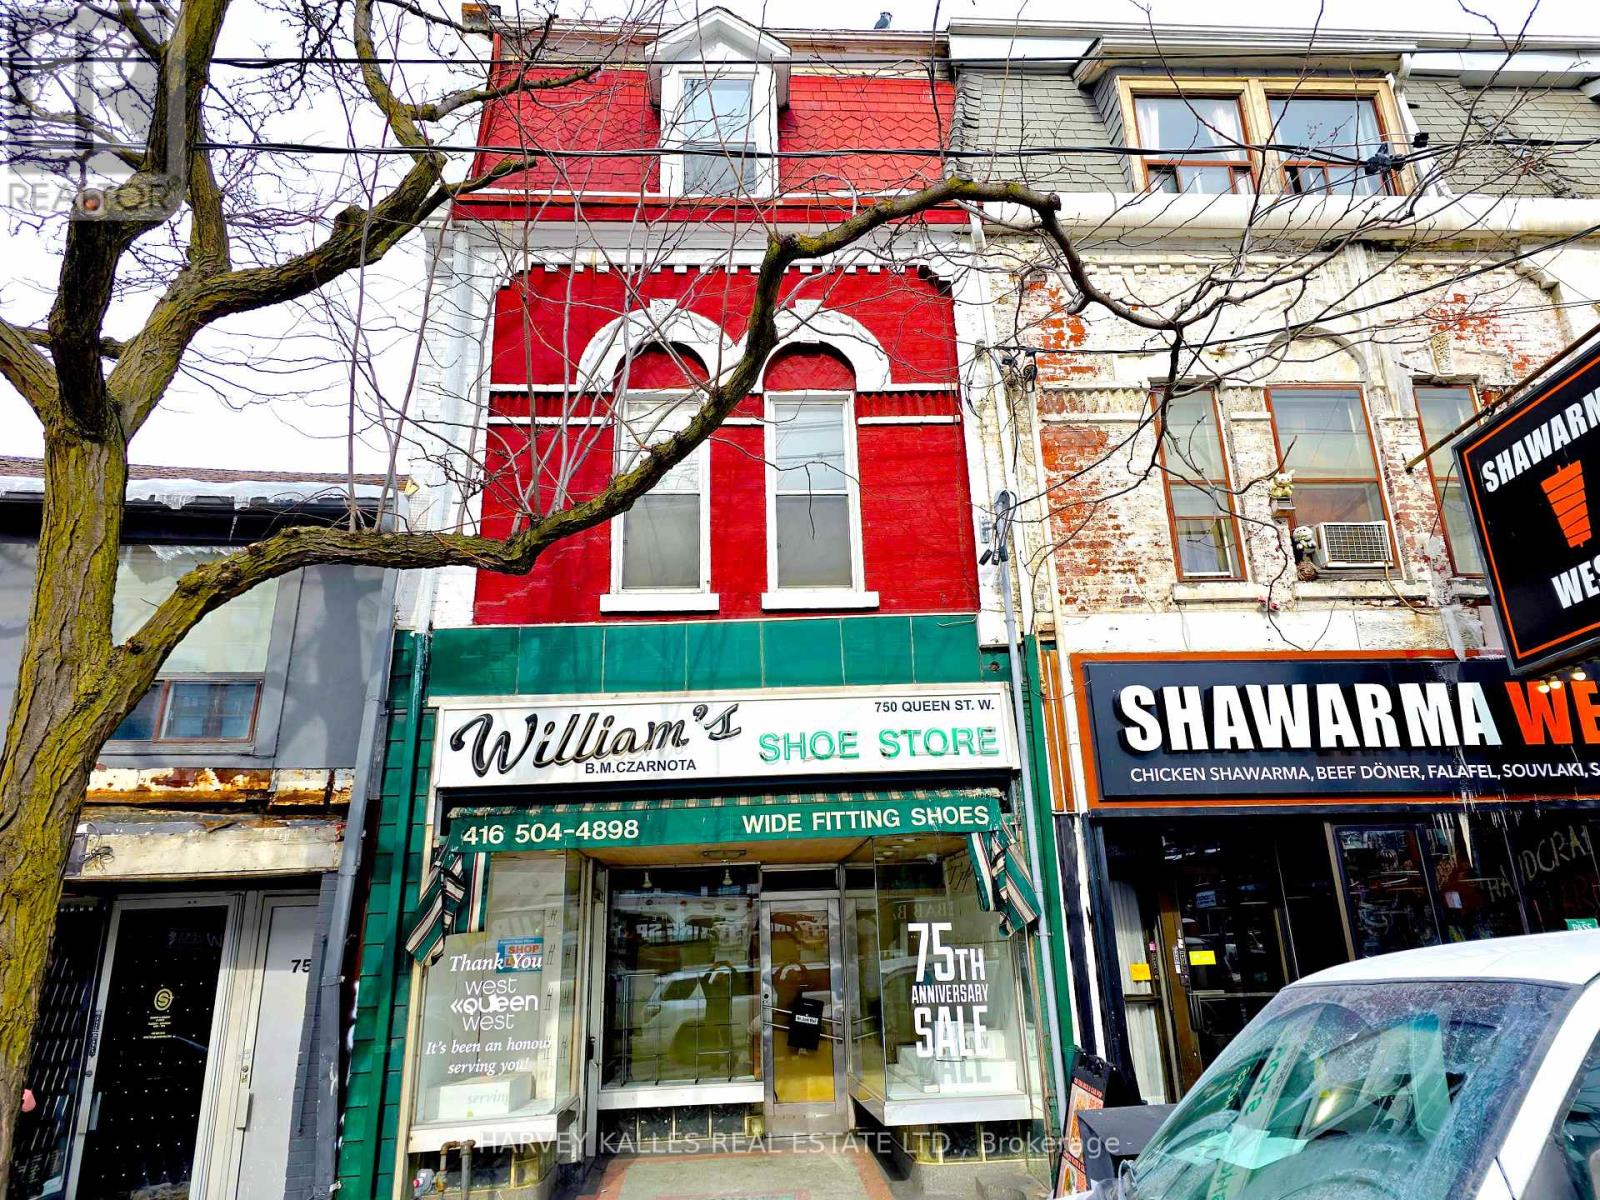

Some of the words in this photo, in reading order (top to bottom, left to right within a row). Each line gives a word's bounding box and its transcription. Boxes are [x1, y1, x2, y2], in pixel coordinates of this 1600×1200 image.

[875, 701, 898, 713] 750
[901, 700, 950, 712] QUEEN
[954, 699, 975, 711] ST.
[978, 698, 995, 710] W.
[1120, 681, 1503, 752] SHAWARMA
[450, 703, 742, 778] William's
[758, 730, 860, 763] SHOE
[878, 727, 1000, 759] STORE
[585, 759, 697, 775] B.M.CZARNOTA
[1130, 767, 1206, 783] CHICKEN
[1210, 766, 1315, 782] SHAWARMA,
[1316, 765, 1357, 780] BEEF
[1361, 762, 1426, 781] DÖNER,
[1428, 763, 1501, 780] FALAFEL,
[1502, 762, 1589, 778] SOUVLAKI,
[743, 813, 802, 834] WIDE
[812, 808, 901, 831] FITTING
[911, 805, 989, 826] SHOES
[462, 824, 505, 846] 416
[514, 819, 639, 844] 504-4898
[508, 944, 539, 954] SHOP
[907, 922, 986, 983] 75TH
[449, 952, 504, 972] Thank
[510, 952, 543, 969] You
[465, 978, 518, 996] west
[911, 983, 989, 1004] ANNIVERSARY
[462, 1013, 515, 1032] west
[913, 1004, 990, 1058] SALE
[425, 1040, 447, 1055] It's
[451, 1039, 481, 1055] been
[485, 1041, 502, 1052] an
[447, 1060, 496, 1076] serving
